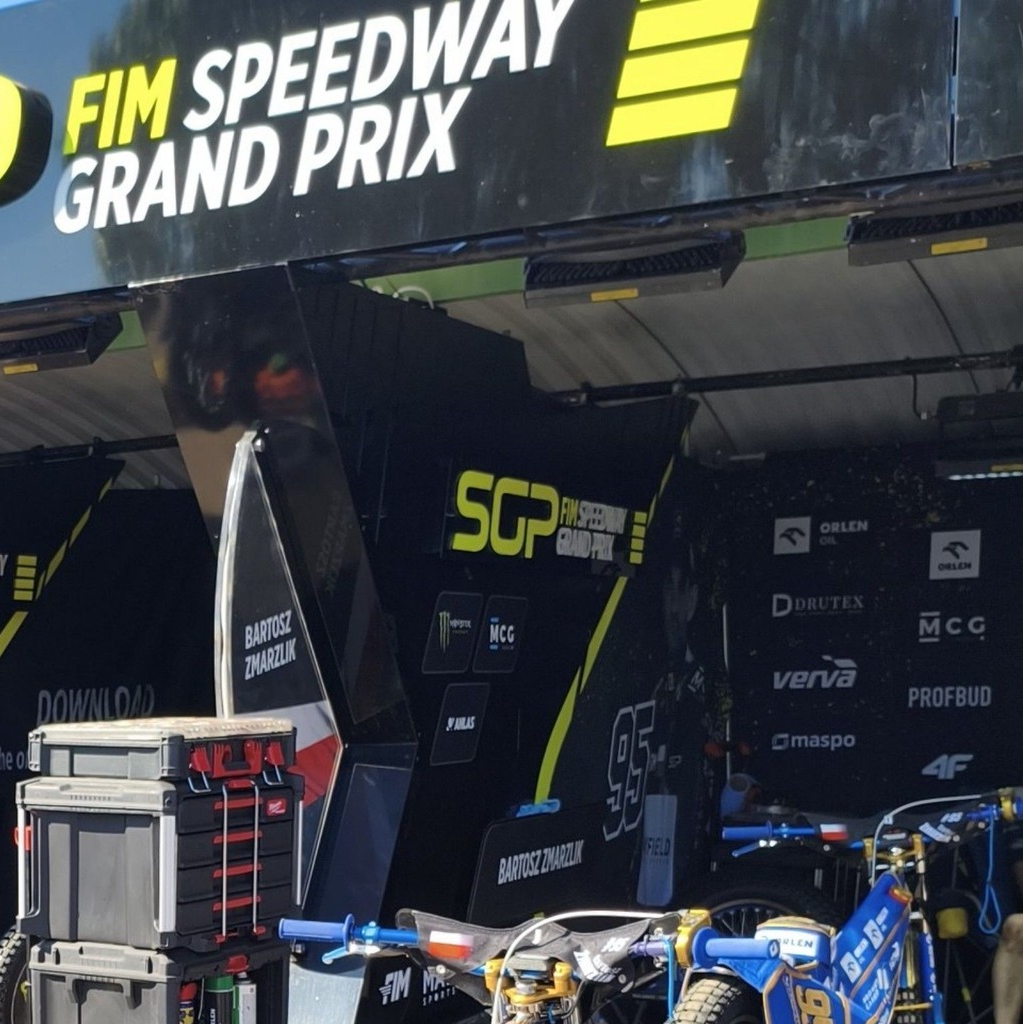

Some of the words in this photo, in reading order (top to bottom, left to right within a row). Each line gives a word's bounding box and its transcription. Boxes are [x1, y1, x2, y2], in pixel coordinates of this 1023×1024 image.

[63, 58, 177, 155] FIM
[182, 0, 576, 133] SPEEDWAY
[53, 126, 280, 235] GRAND
[293, 87, 471, 196] PRIX
[452, 470, 559, 559] SGP
[560, 497, 578, 527] FIM
[820, 520, 868, 534] ORLEN
[820, 535, 838, 546] OIL
[938, 562, 972, 572] ORLEN
[795, 595, 865, 612] DRUTEX
[244, 610, 292, 651] BARTOSZ
[490, 624, 515, 643] MCG
[919, 616, 986, 636] MCG
[244, 642, 297, 681] ZMARZLIK
[773, 670, 857, 690] verva
[37, 685, 155, 725] DOWNLOAD
[909, 686, 992, 707] PROFBUD
[791, 734, 856, 750] maspo
[603, 700, 655, 841] 95
[921, 754, 974, 779] 4F
[647, 837, 671, 857] FIELD
[498, 847, 541, 884] BARTOSZ
[541, 840, 584, 874] ZMARZLIK
[379, 967, 411, 1006] FIM
